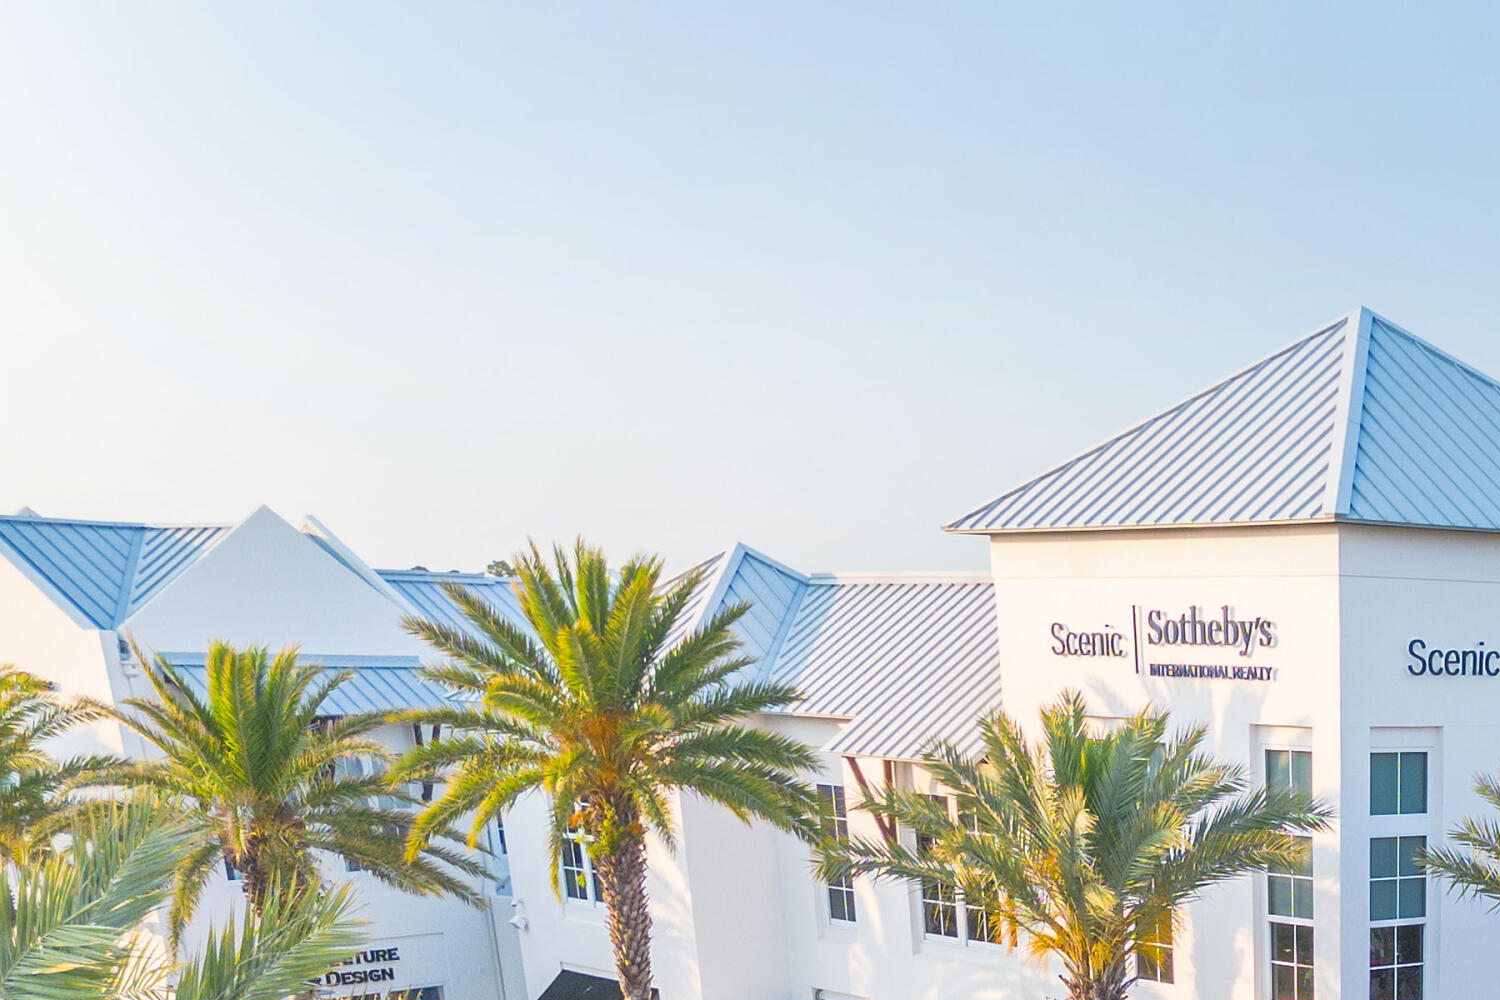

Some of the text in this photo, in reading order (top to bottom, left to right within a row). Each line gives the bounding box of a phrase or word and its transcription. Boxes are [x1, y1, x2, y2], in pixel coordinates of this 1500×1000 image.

[1050, 604, 1273, 657] Scenic Sotheby's
[1407, 638, 1500, 676] Scenic
[1149, 663, 1273, 681] INTERNATIONAL REALTY
[325, 967, 395, 986] DESIGN
